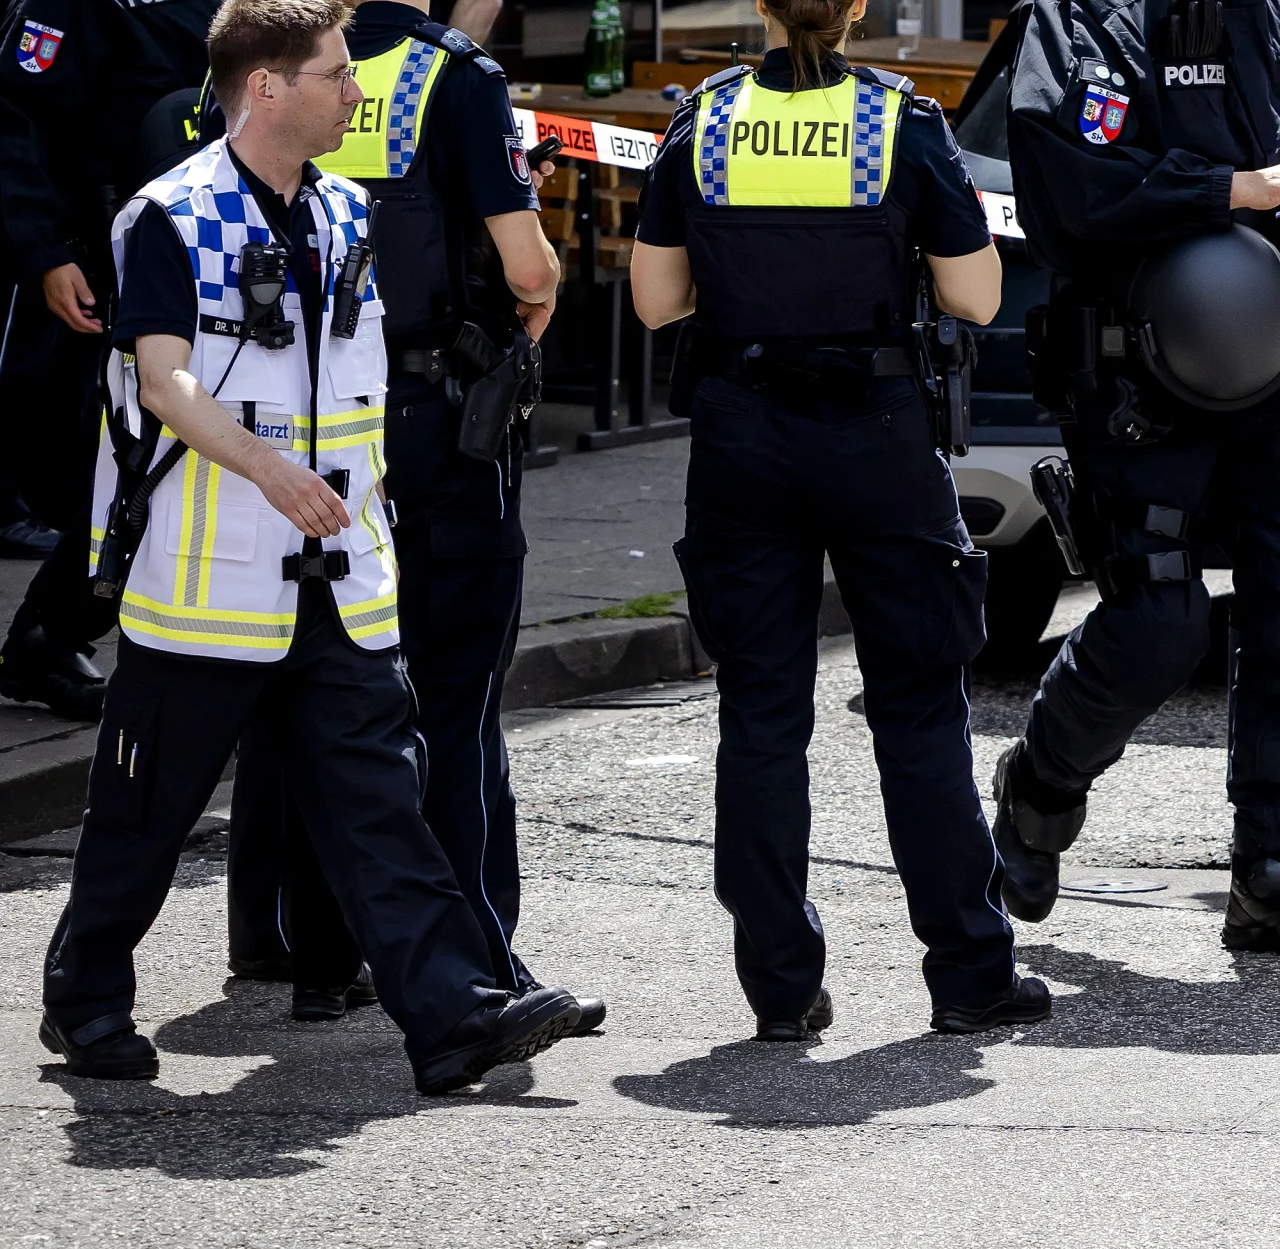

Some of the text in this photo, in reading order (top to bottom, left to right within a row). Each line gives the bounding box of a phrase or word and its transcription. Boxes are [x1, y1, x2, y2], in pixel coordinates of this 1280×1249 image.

[25, 60, 37, 71] SH
[537, 122, 598, 153] POLIZEI
[610, 135, 658, 162] OLIZEI
[731, 120, 850, 158] POLIZEI
[1090, 132, 1104, 142] SH
[214, 320, 228, 333] DR.
[237, 417, 289, 440] tarzt
